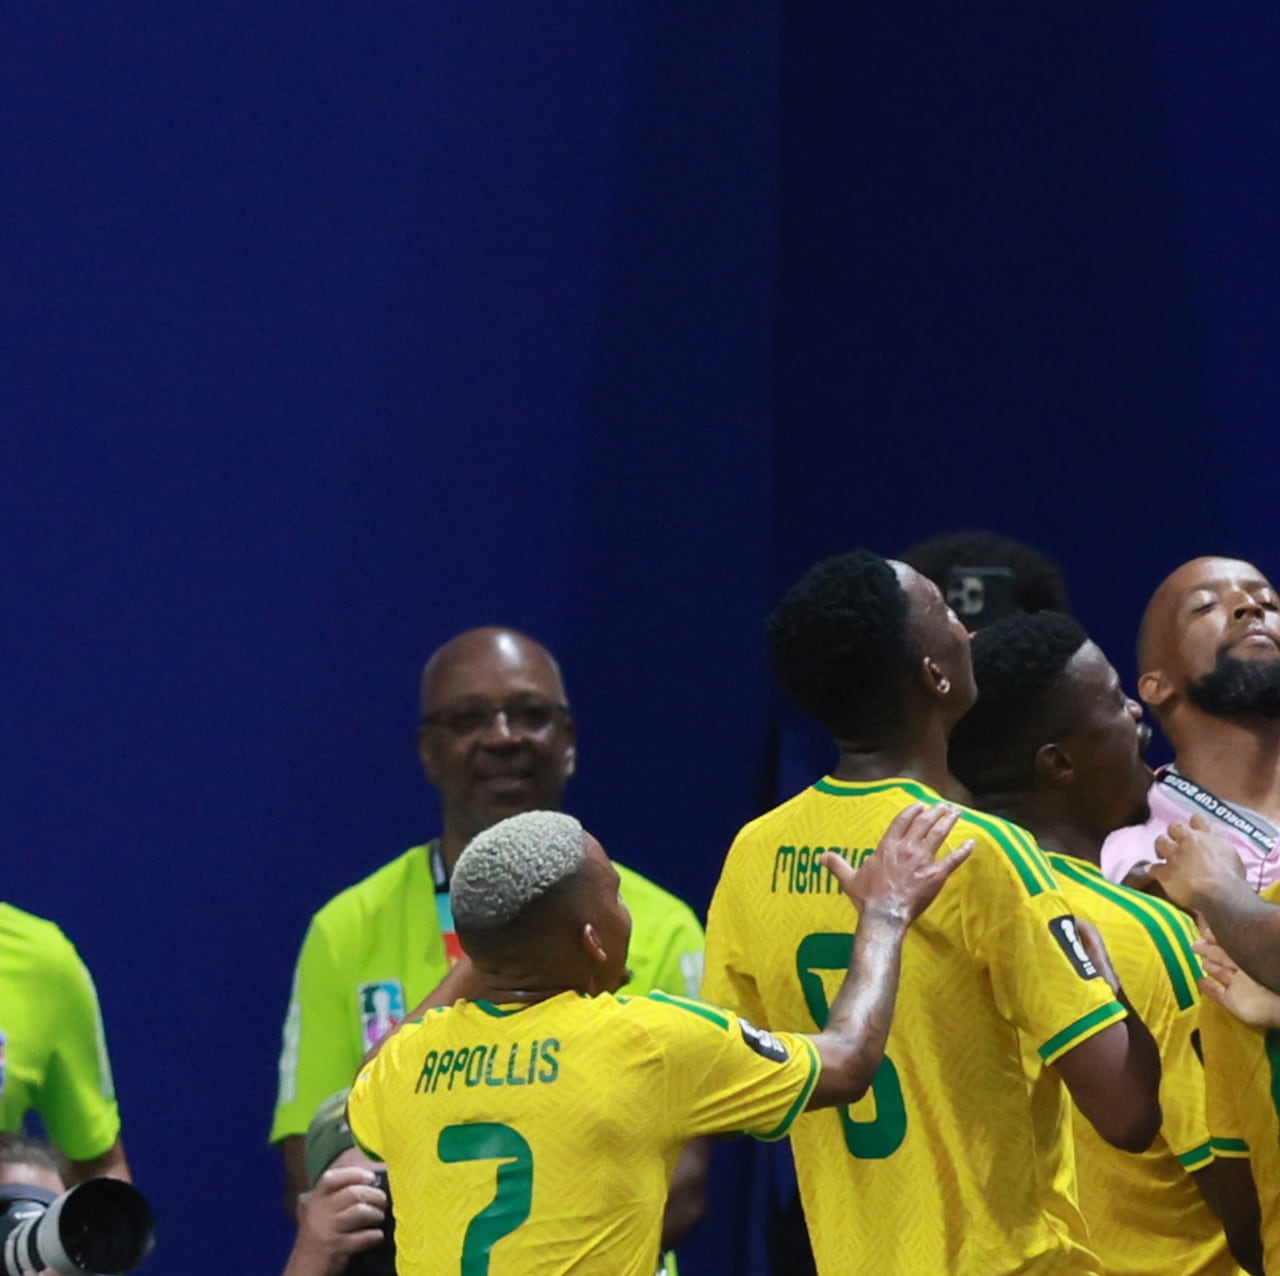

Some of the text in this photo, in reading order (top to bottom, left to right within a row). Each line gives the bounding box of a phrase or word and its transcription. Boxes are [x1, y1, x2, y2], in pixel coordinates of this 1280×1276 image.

[1195, 792, 1218, 811] CUP
[1216, 806, 1254, 836] WORLD
[415, 1038, 560, 1093] APPOLLIS
